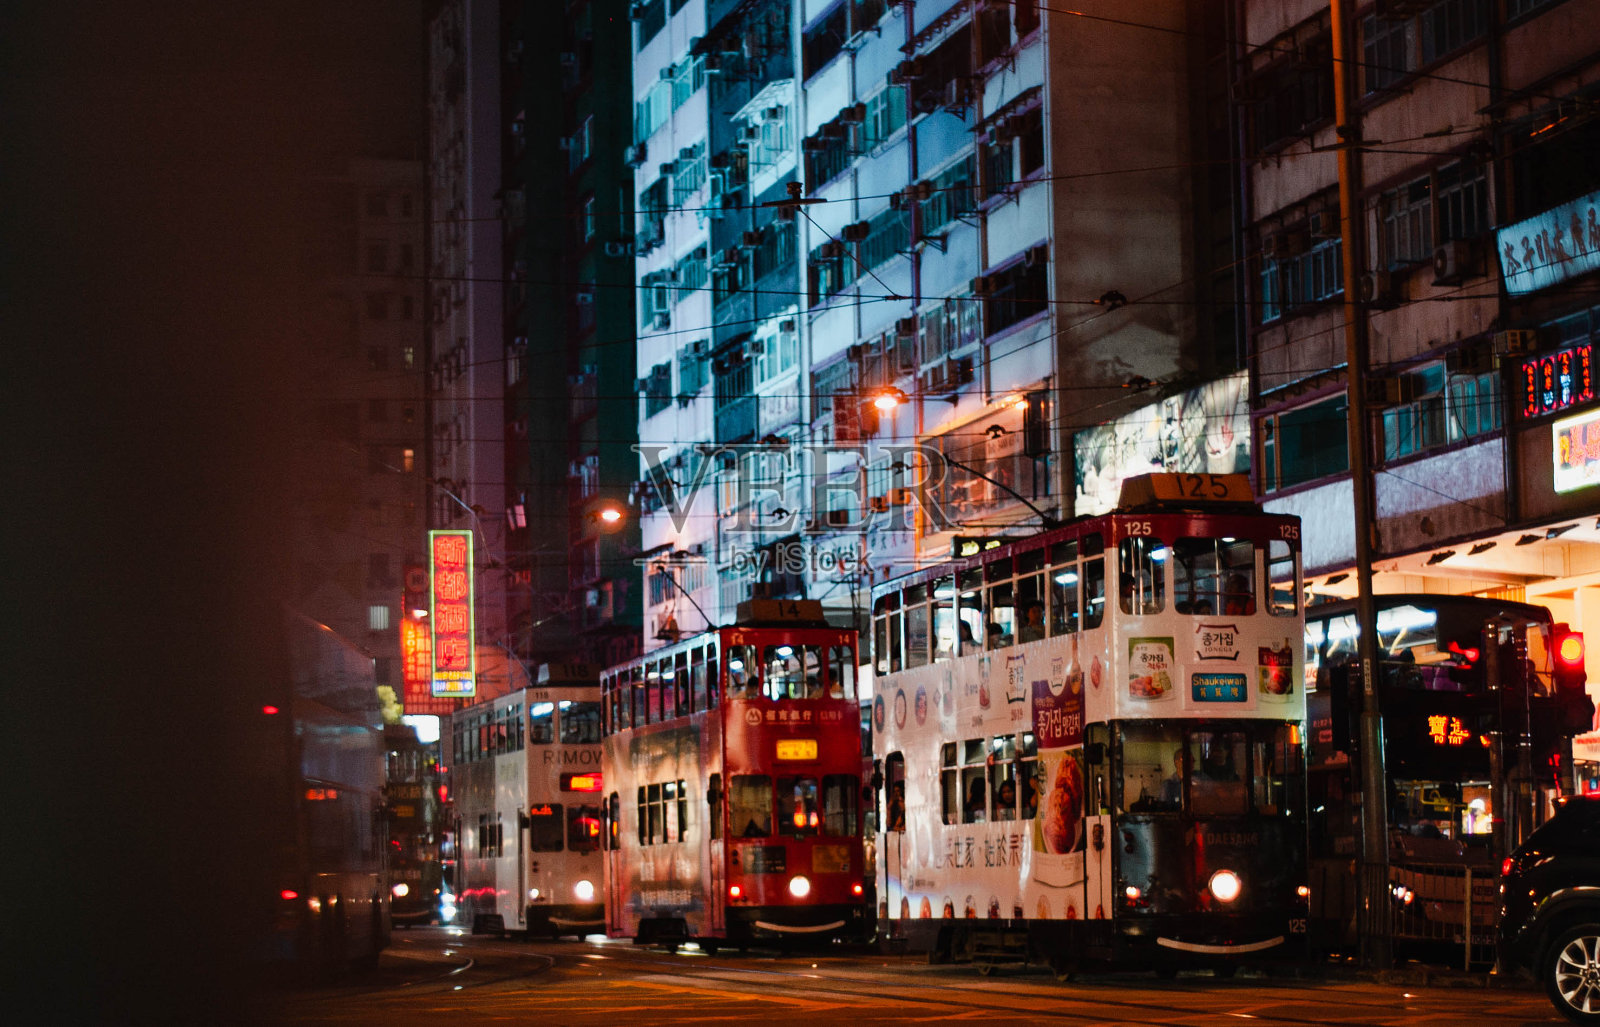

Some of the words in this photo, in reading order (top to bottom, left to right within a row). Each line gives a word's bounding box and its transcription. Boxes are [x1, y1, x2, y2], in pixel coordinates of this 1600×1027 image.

[1175, 475, 1229, 499] 125
[1125, 521, 1152, 536] 125
[1279, 524, 1299, 539] 125
[778, 602, 801, 617] 14
[730, 632, 745, 645] 14
[838, 634, 850, 644] 14
[1202, 632, 1234, 647] 종가집
[562, 664, 589, 678] 118
[1192, 677, 1245, 686] Shaukeiwan
[1038, 708, 1062, 740] 종가집
[1434, 735, 1444, 743] PO
[1448, 735, 1463, 744] TAT
[1288, 919, 1306, 933] 125
